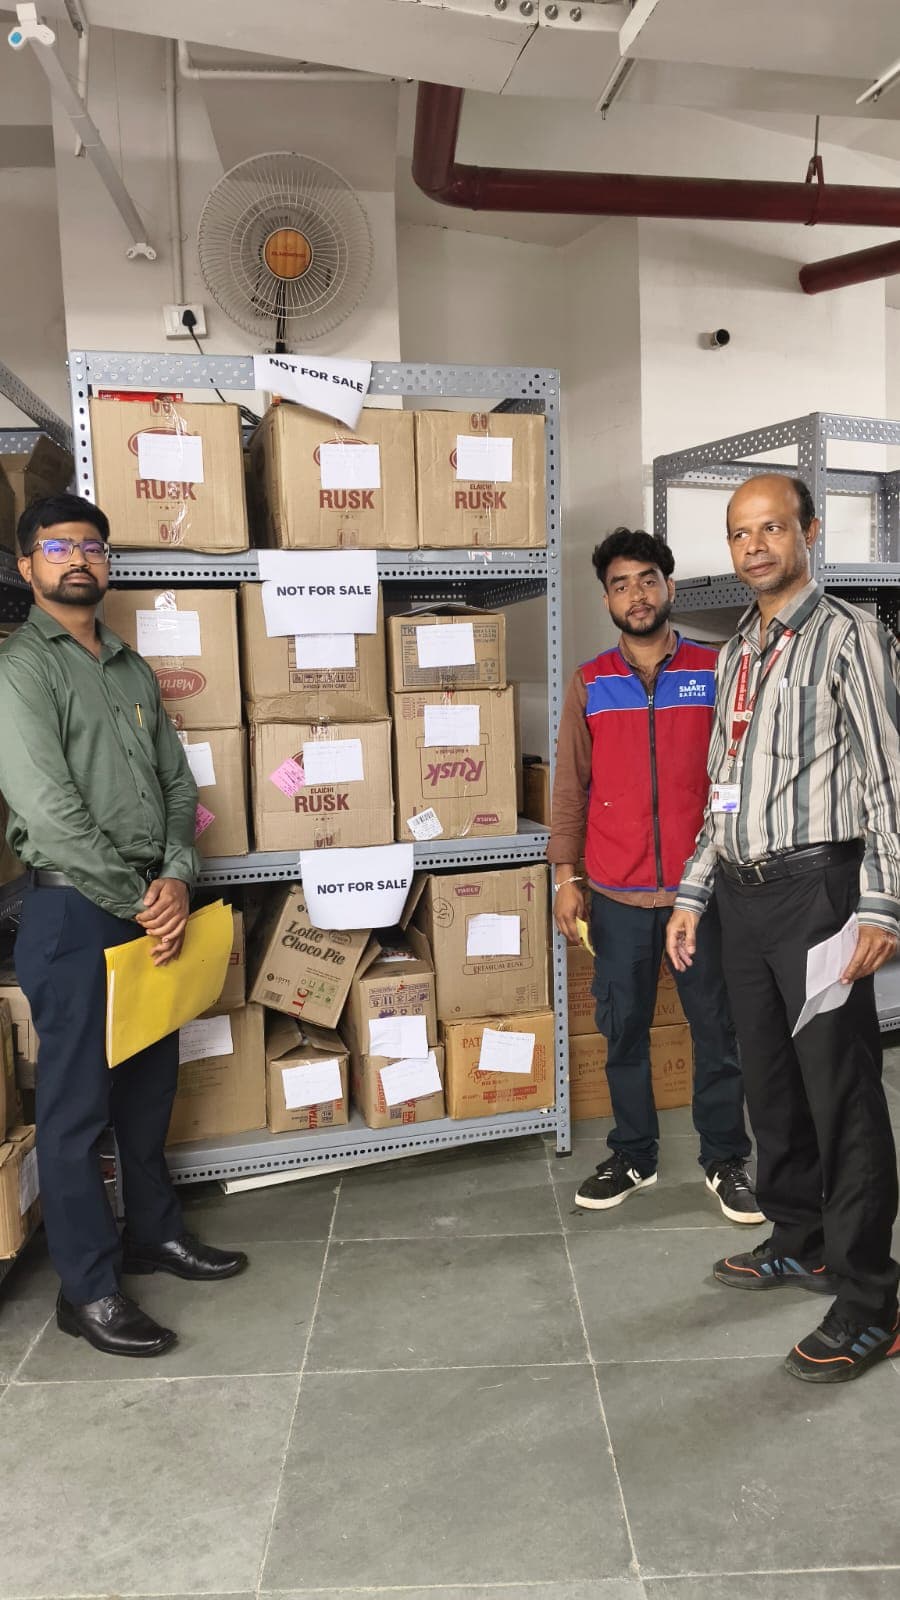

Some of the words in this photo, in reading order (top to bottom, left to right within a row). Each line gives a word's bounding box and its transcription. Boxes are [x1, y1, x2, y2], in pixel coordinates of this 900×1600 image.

[269, 358, 298, 373] NOT
[301, 367, 329, 381] FOR
[332, 375, 364, 393] SALE
[320, 490, 375, 509] RUSK
[455, 491, 507, 509] RUSK
[277, 586, 305, 596] NOT
[308, 586, 336, 596] FOR
[339, 585, 372, 595] SALE
[161, 679, 195, 691] Marin
[424, 757, 484, 786] Rusk
[295, 793, 350, 813] RUSK
[317, 883, 344, 895] NOT
[347, 881, 374, 892] FOR
[377, 879, 407, 890] SALE
[285, 920, 324, 943] Lotte
[281, 934, 322, 957] Choco
[321, 948, 346, 965] Pie
[462, 1037, 480, 1049] PAT
